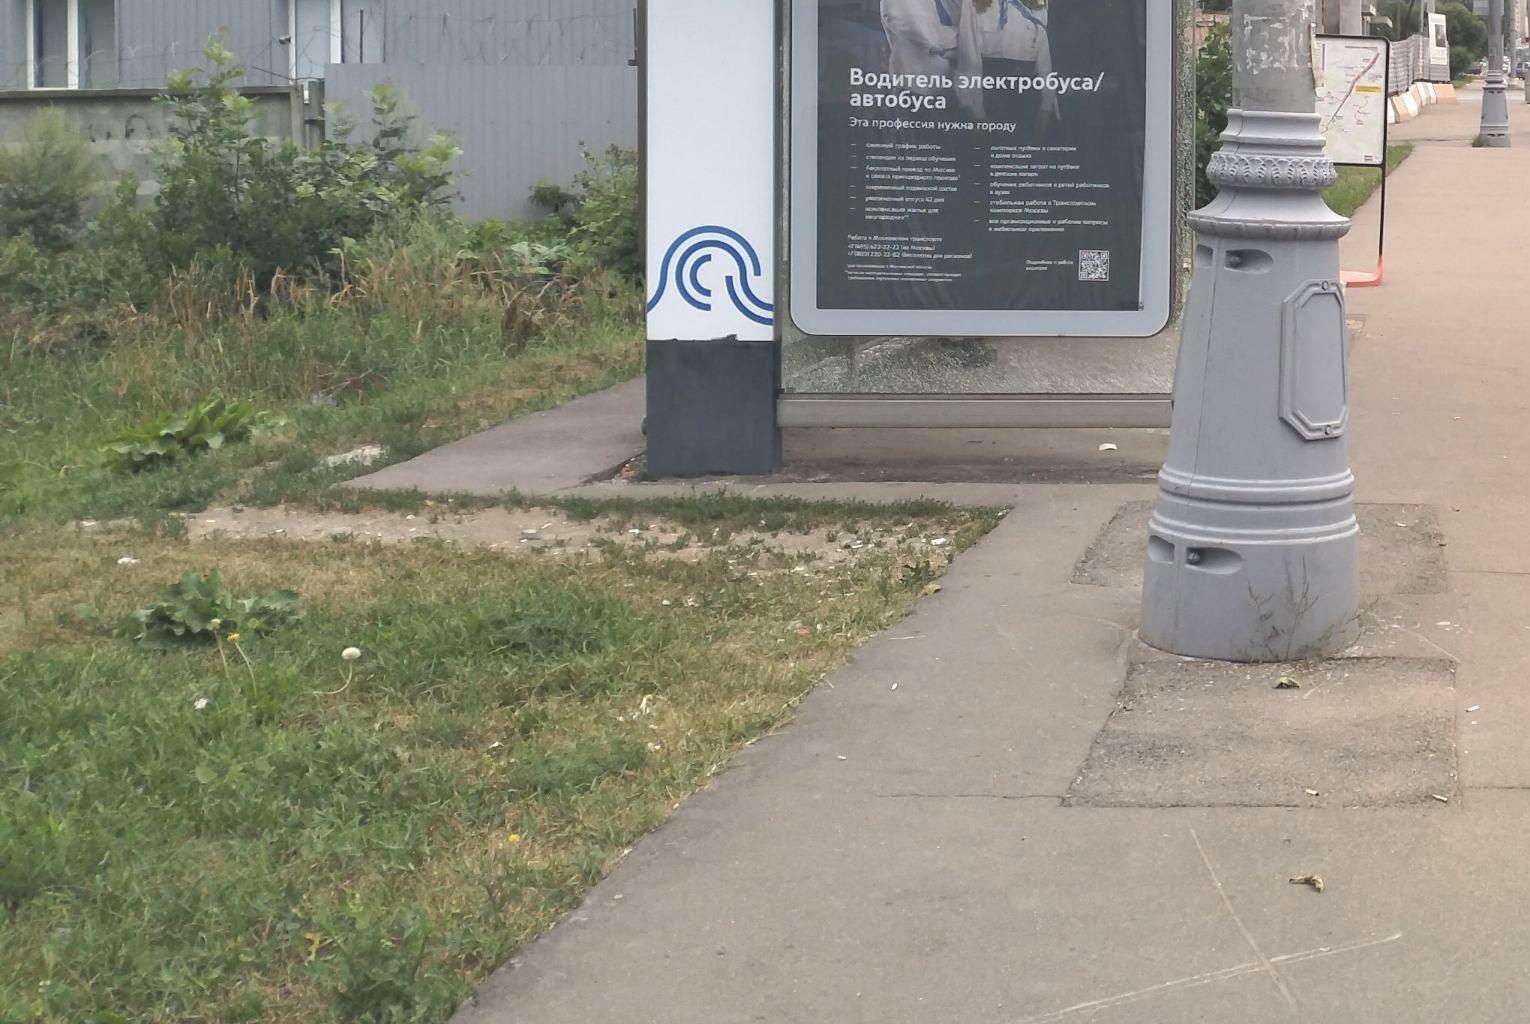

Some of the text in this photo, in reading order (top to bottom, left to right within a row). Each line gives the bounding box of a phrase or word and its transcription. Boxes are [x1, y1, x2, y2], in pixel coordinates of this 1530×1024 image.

[850, 68, 1105, 94] Водитель электробуса/
[850, 91, 947, 112] автобуса
[849, 117, 1017, 133] Эта профессия нужна городу
